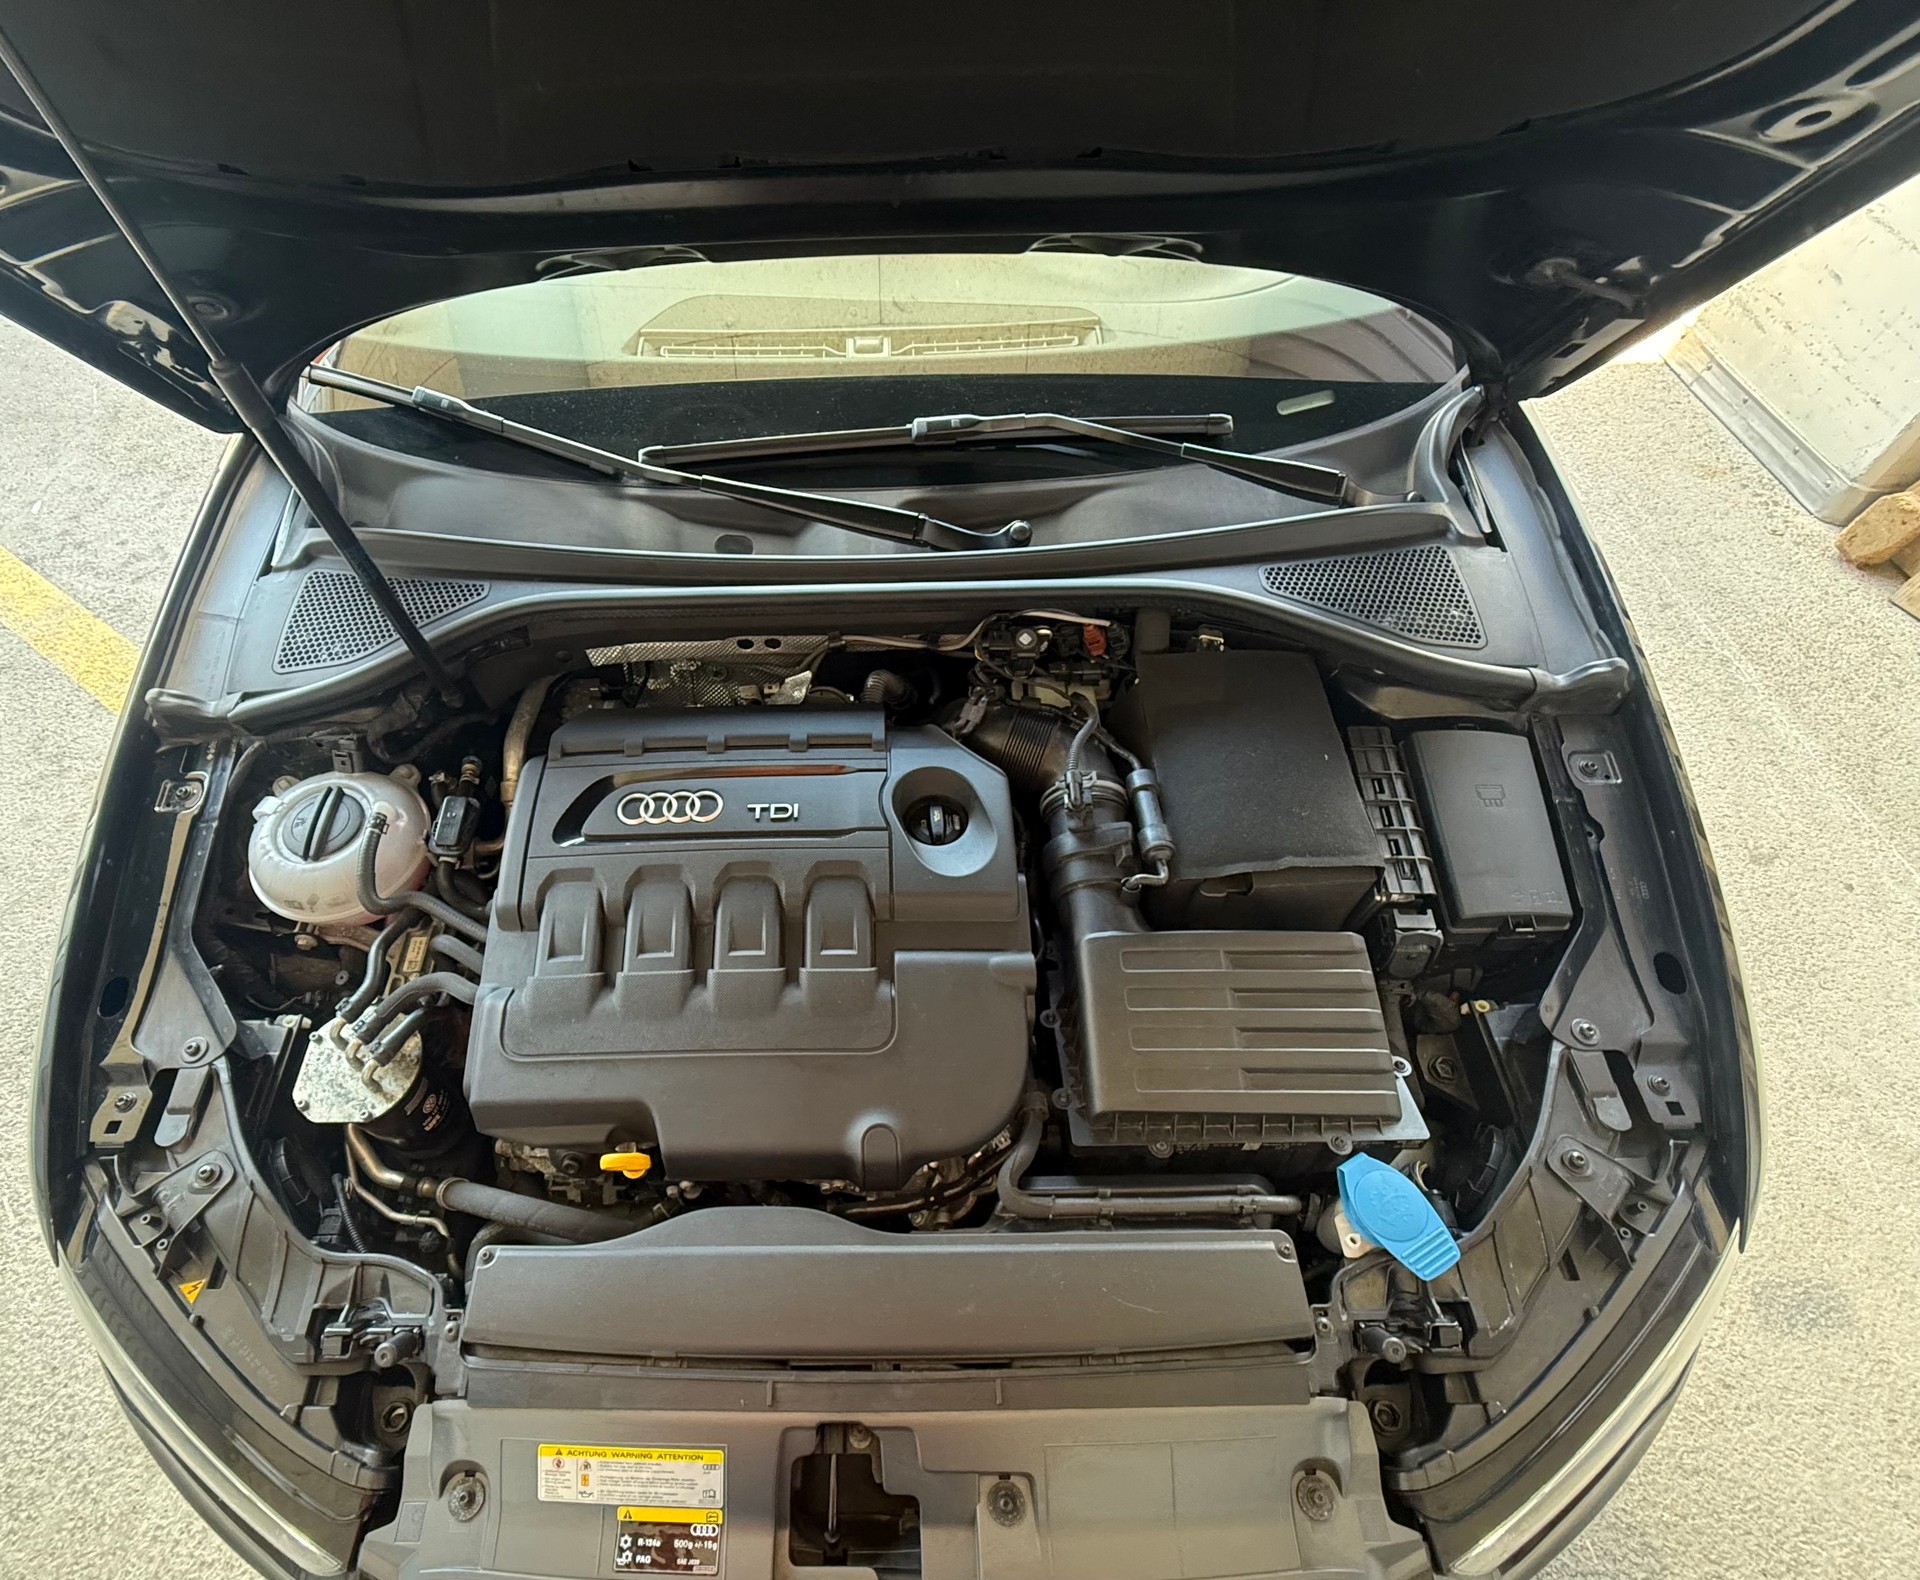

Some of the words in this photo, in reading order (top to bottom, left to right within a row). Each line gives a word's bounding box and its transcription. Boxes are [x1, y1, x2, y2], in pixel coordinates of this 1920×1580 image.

[747, 802, 799, 821] TDI
[566, 1449, 607, 1458] ACHTUNG
[611, 1451, 653, 1459] WARNING
[656, 1453, 704, 1461] ATTENTION
